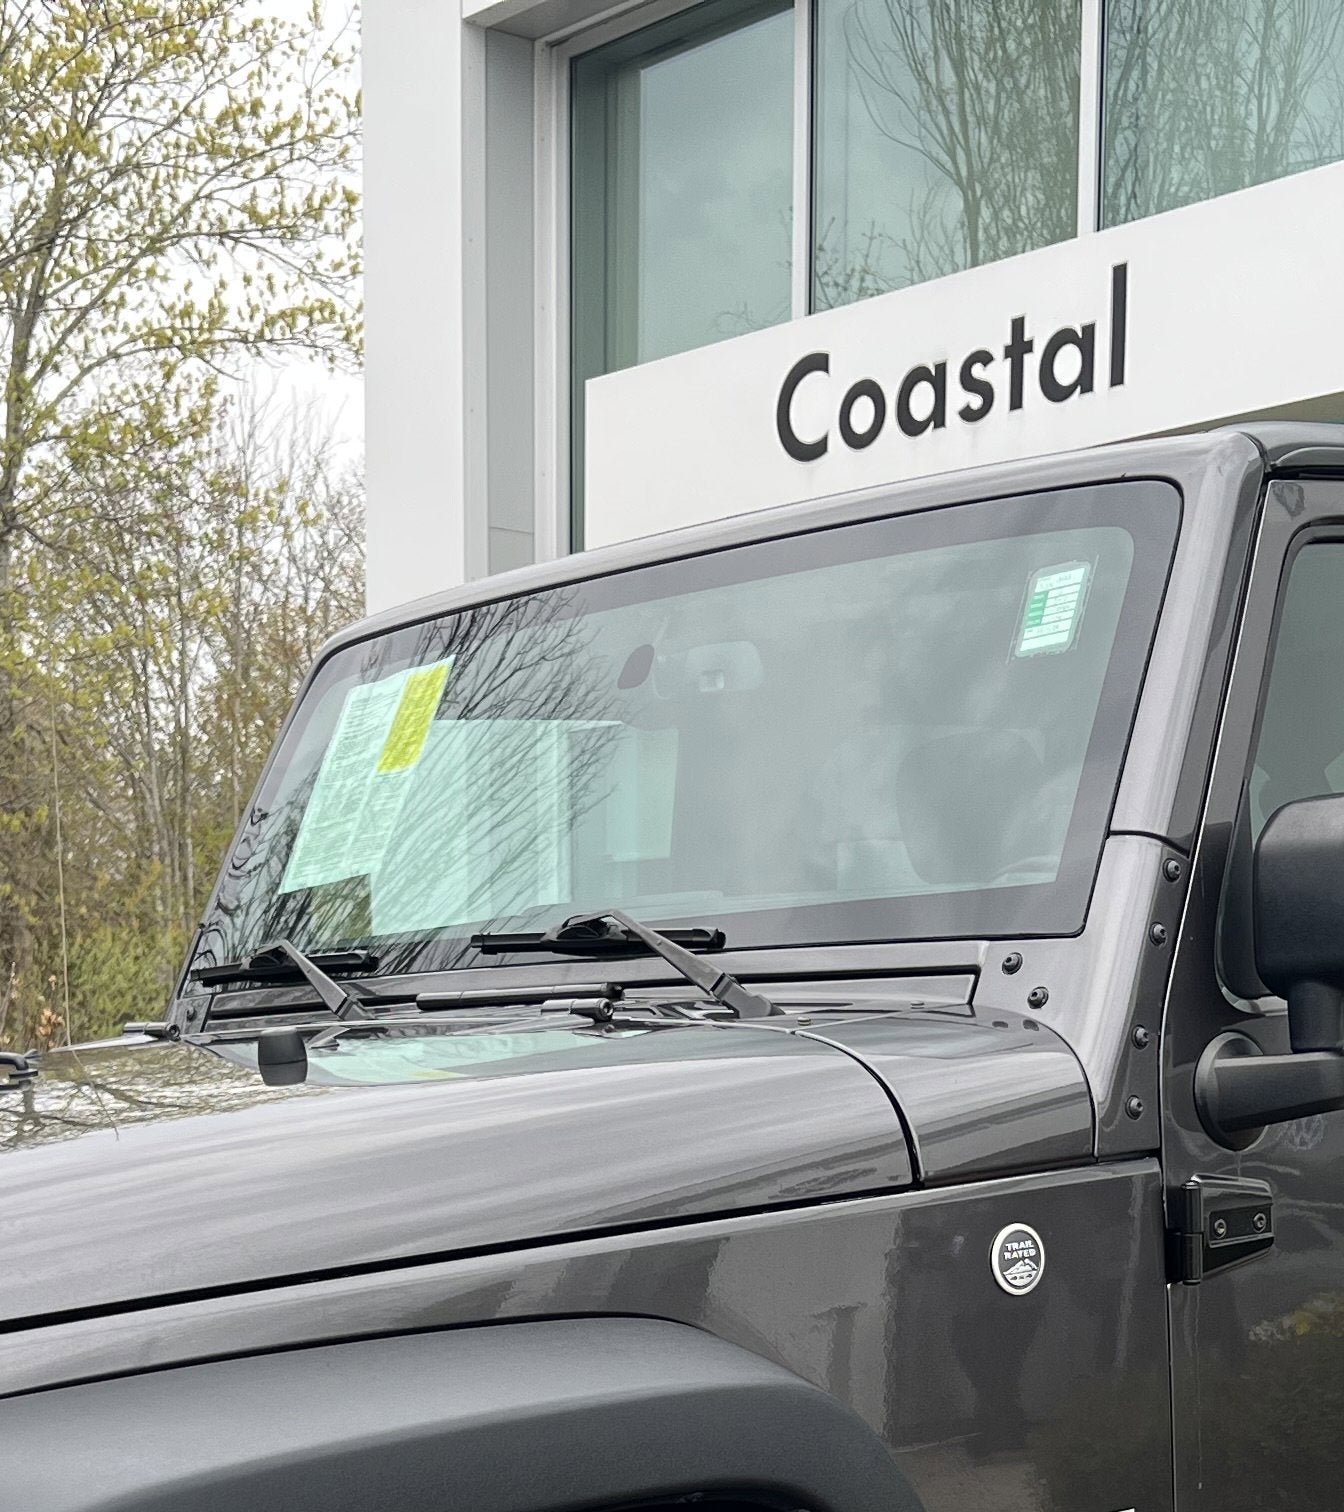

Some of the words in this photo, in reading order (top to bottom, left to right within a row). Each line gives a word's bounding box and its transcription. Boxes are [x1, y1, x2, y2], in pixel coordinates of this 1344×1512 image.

[774, 262, 1128, 464] Coastal
[1005, 1240, 1035, 1252] TRAIL
[1003, 1248, 1037, 1261] RATED
